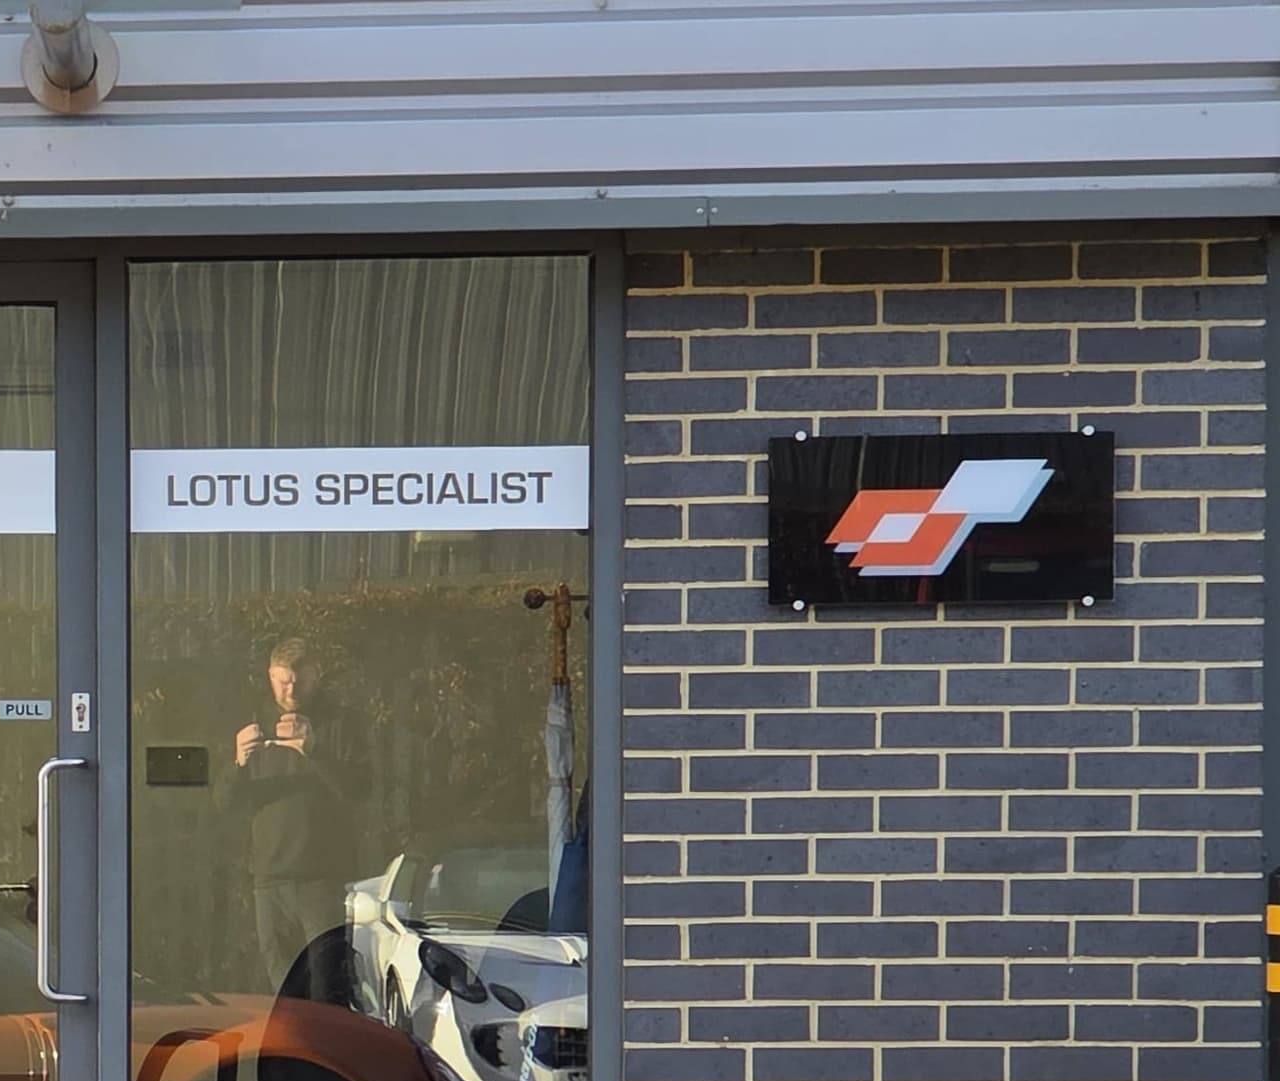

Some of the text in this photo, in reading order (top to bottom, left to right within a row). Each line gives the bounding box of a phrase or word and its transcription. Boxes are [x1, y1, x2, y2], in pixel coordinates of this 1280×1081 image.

[167, 471, 553, 507] LOTUS SPECIALIST
[5, 703, 43, 716] PULL
